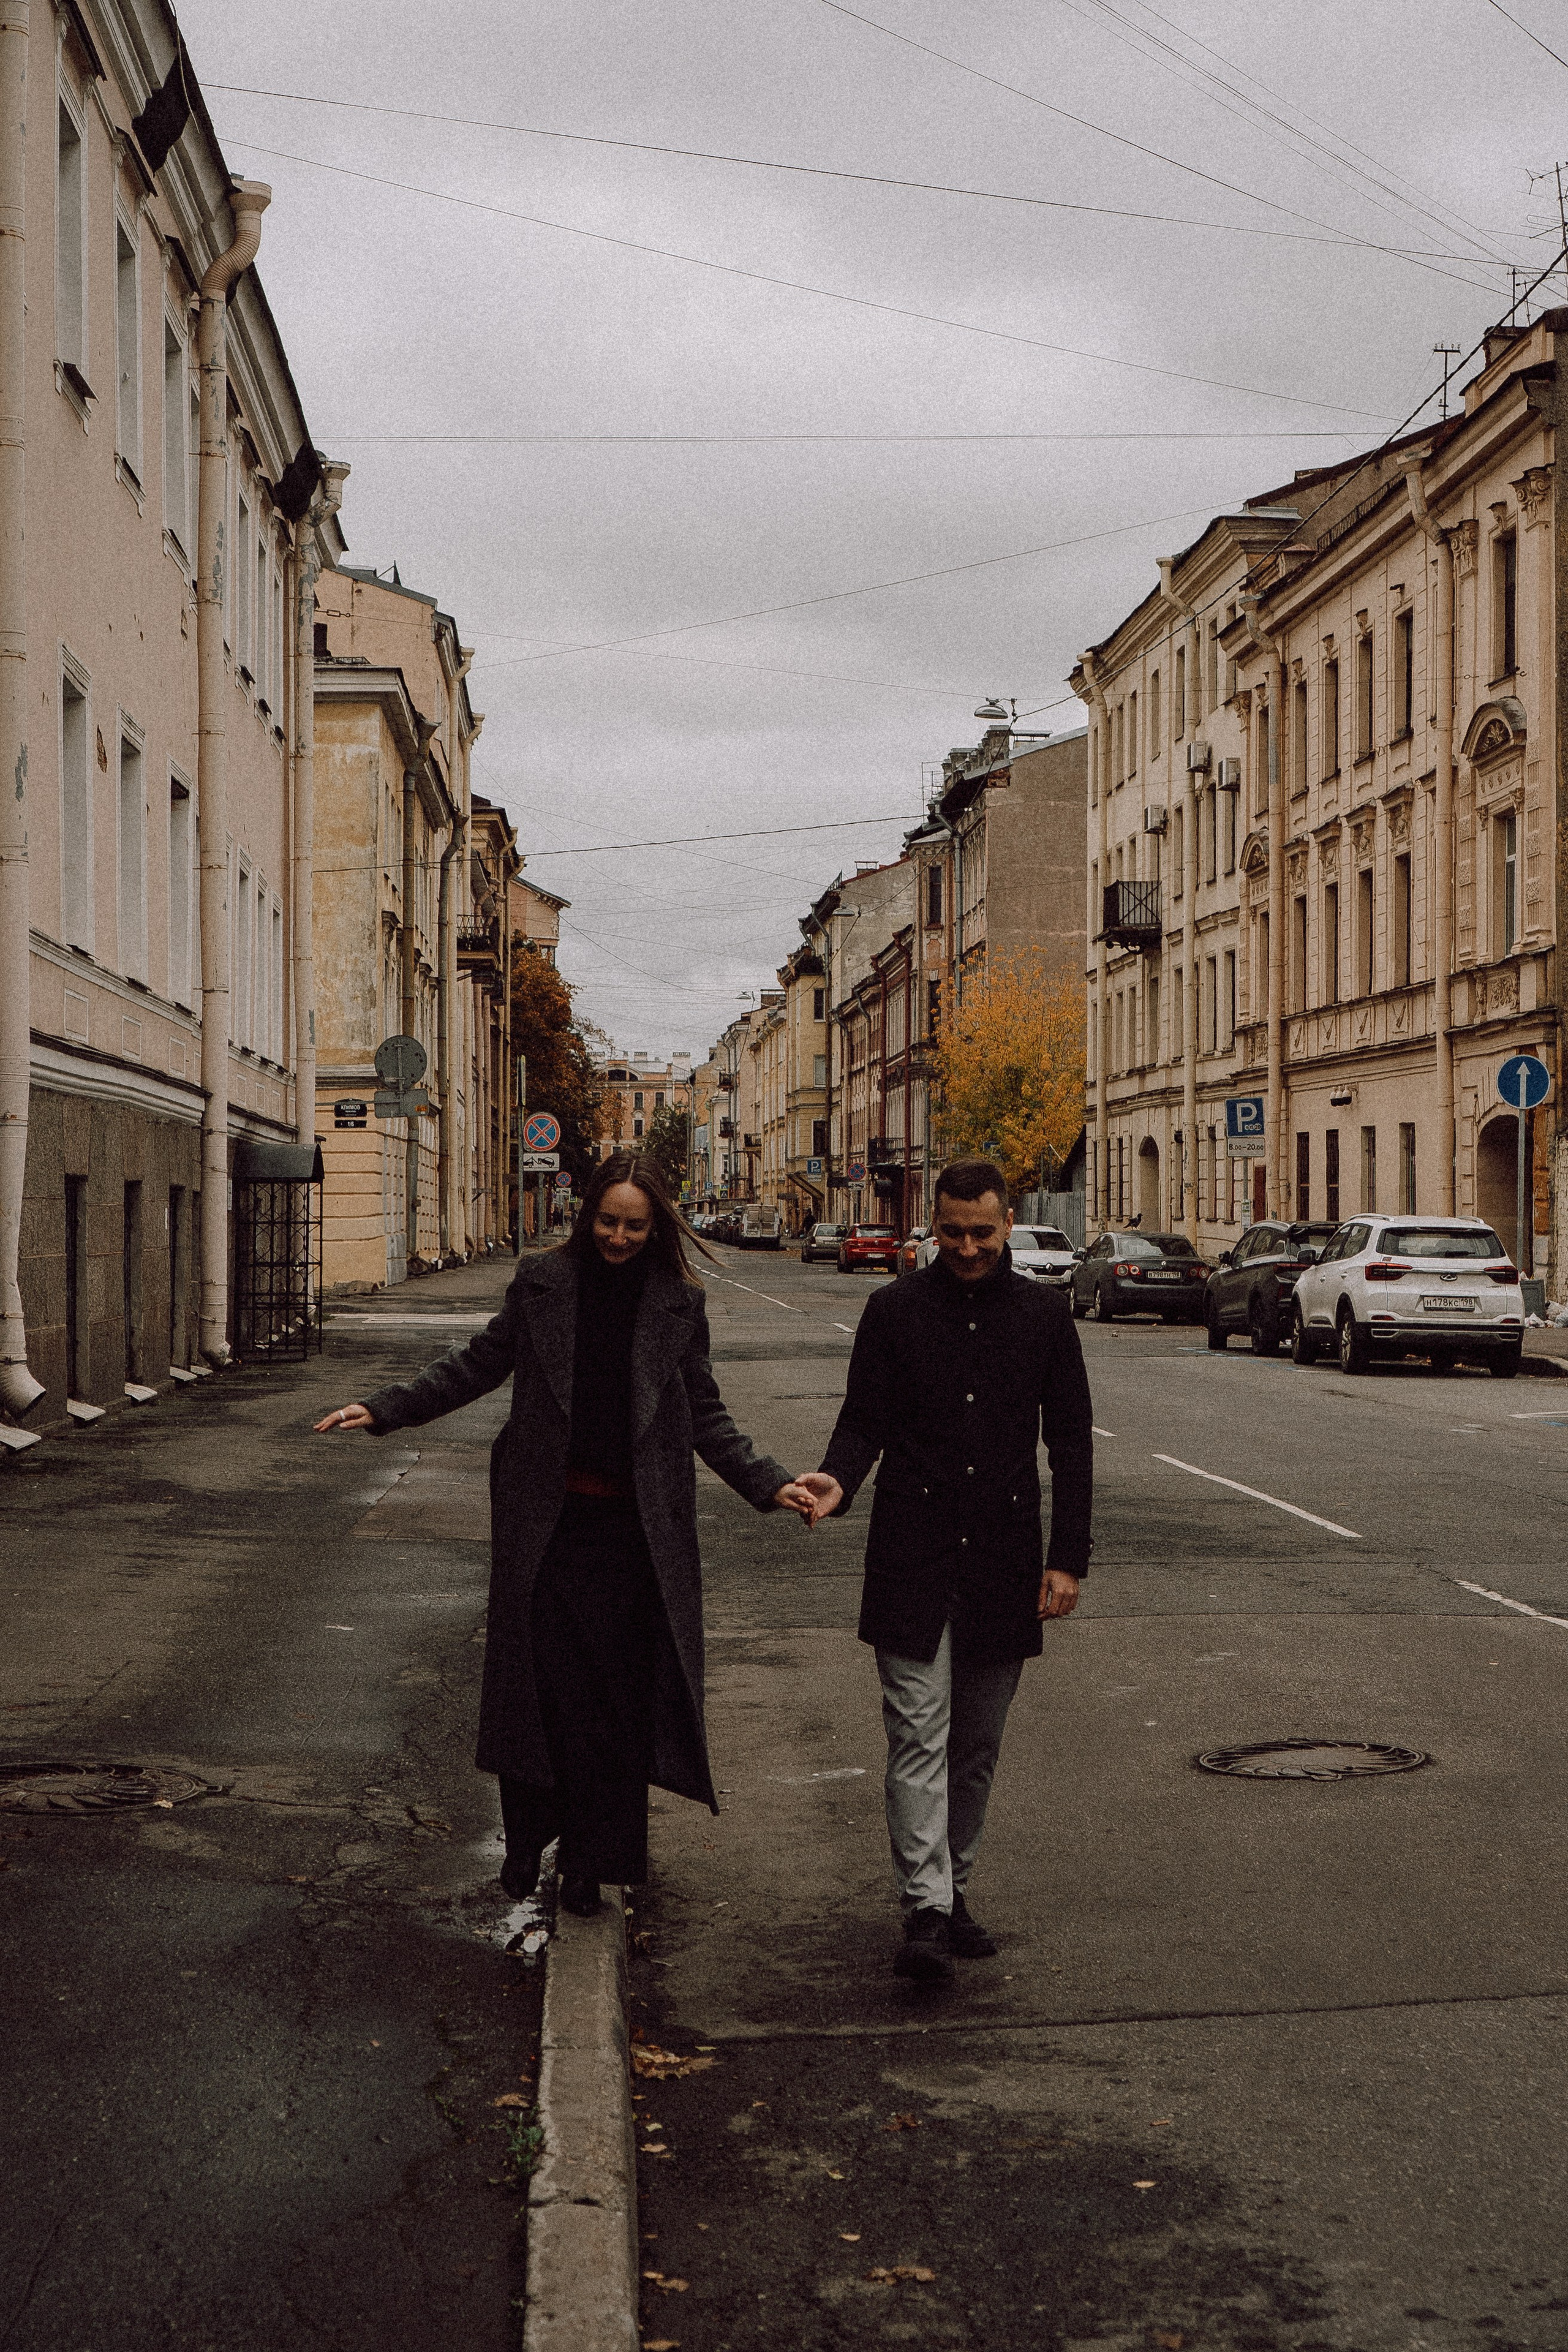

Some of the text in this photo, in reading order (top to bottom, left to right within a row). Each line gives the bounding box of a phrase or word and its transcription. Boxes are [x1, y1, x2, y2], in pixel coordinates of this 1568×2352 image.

[1236, 1102, 1257, 1132] P
[811, 1161, 819, 1172] P
[1427, 1298, 1458, 1306] Н178КС
